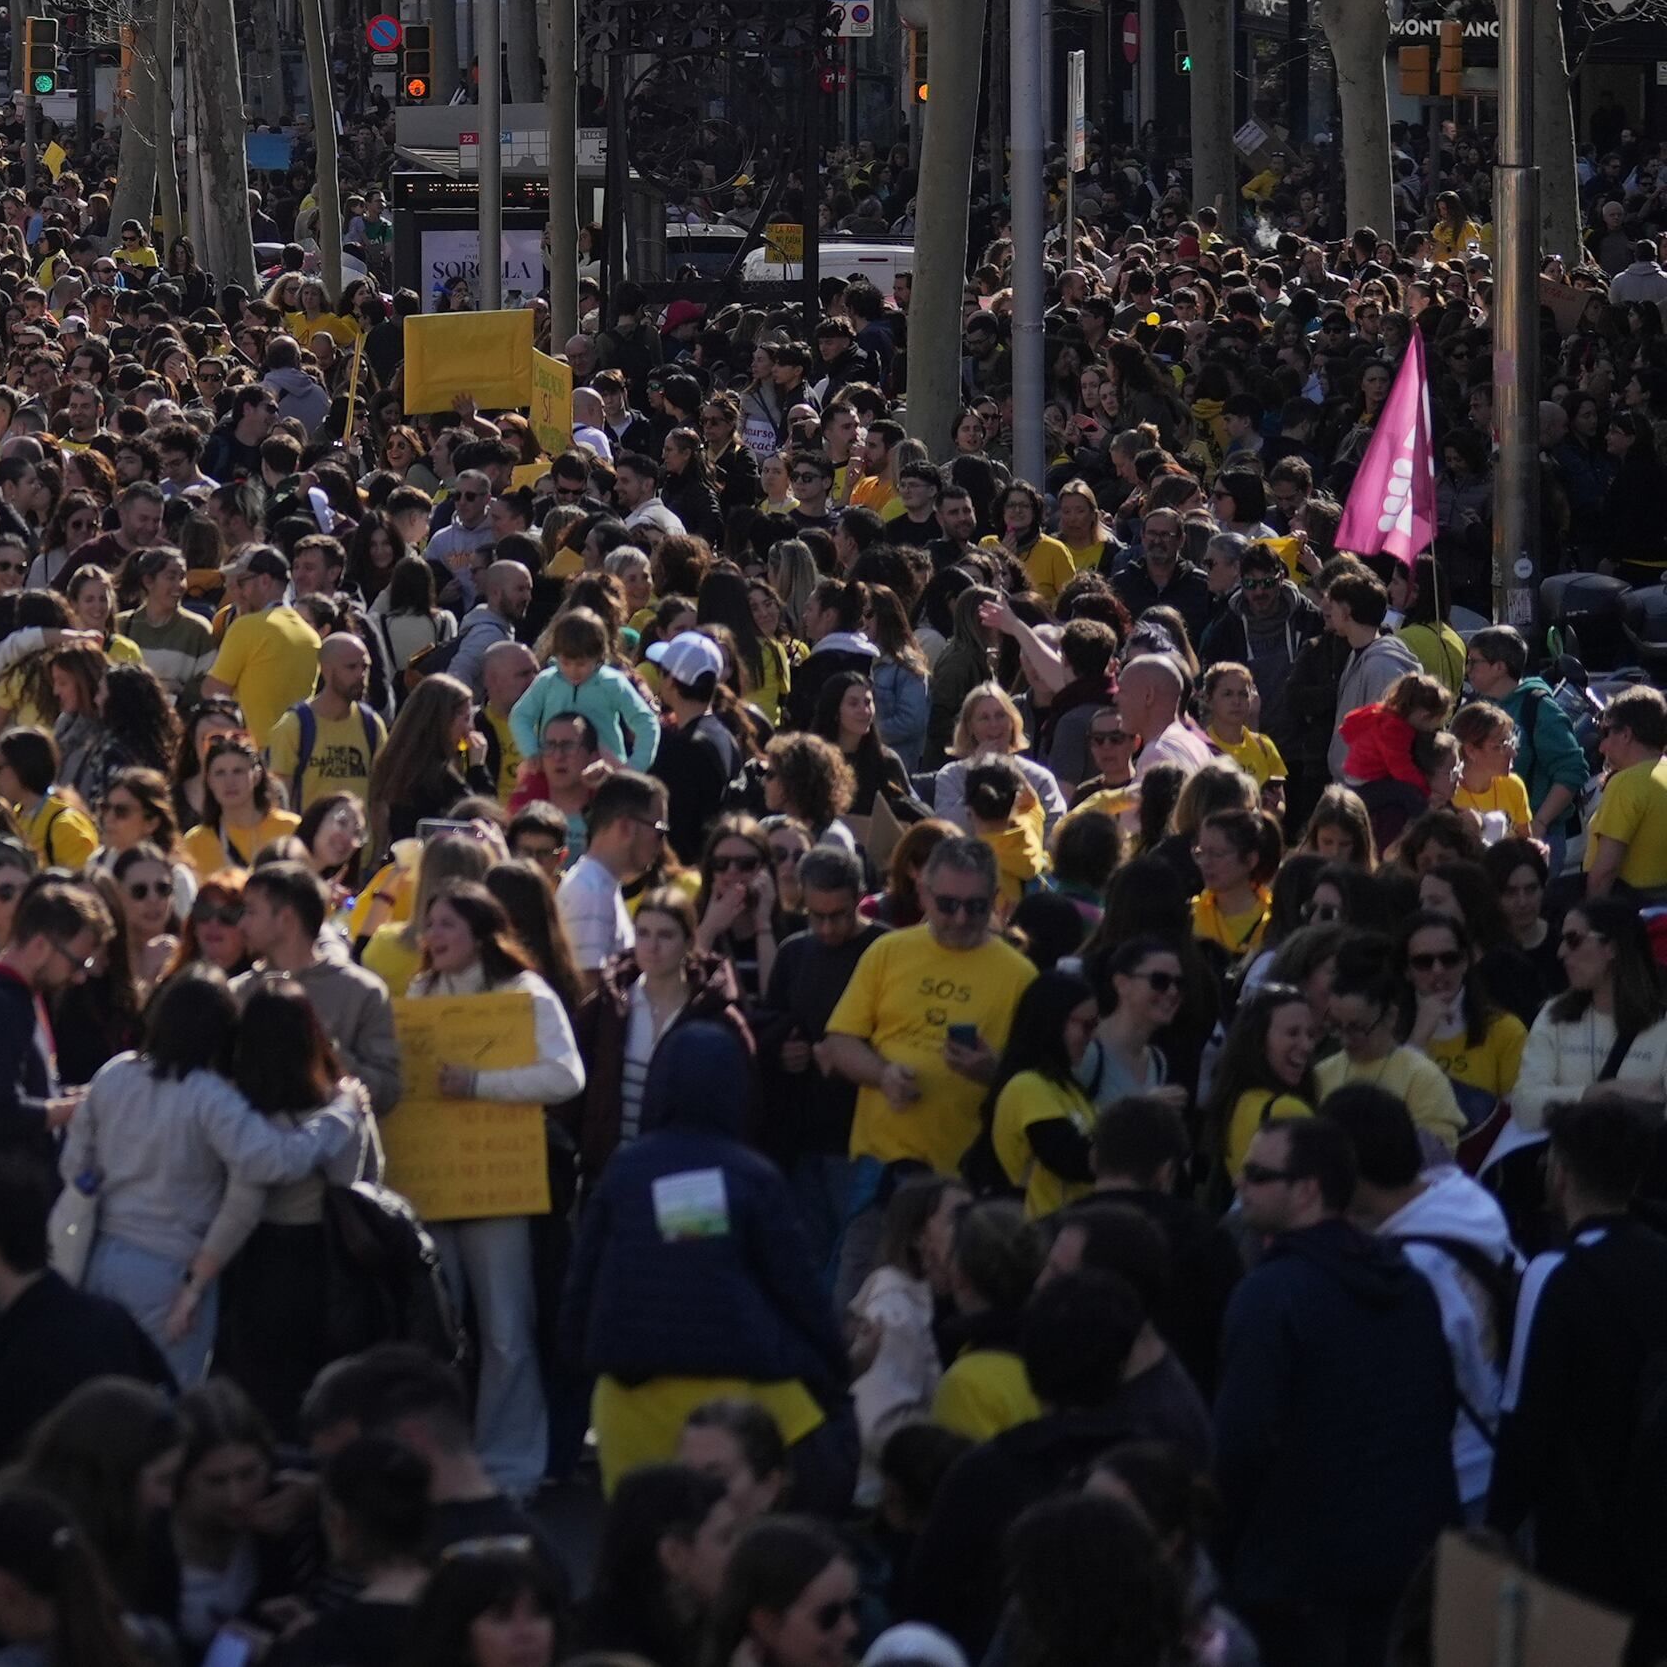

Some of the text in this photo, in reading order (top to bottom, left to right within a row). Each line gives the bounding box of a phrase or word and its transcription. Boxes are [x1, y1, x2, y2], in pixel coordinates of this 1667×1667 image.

[462, 134, 474, 143] 22
[917, 976, 972, 1003] SOS
[1435, 1054, 1468, 1073] OS
